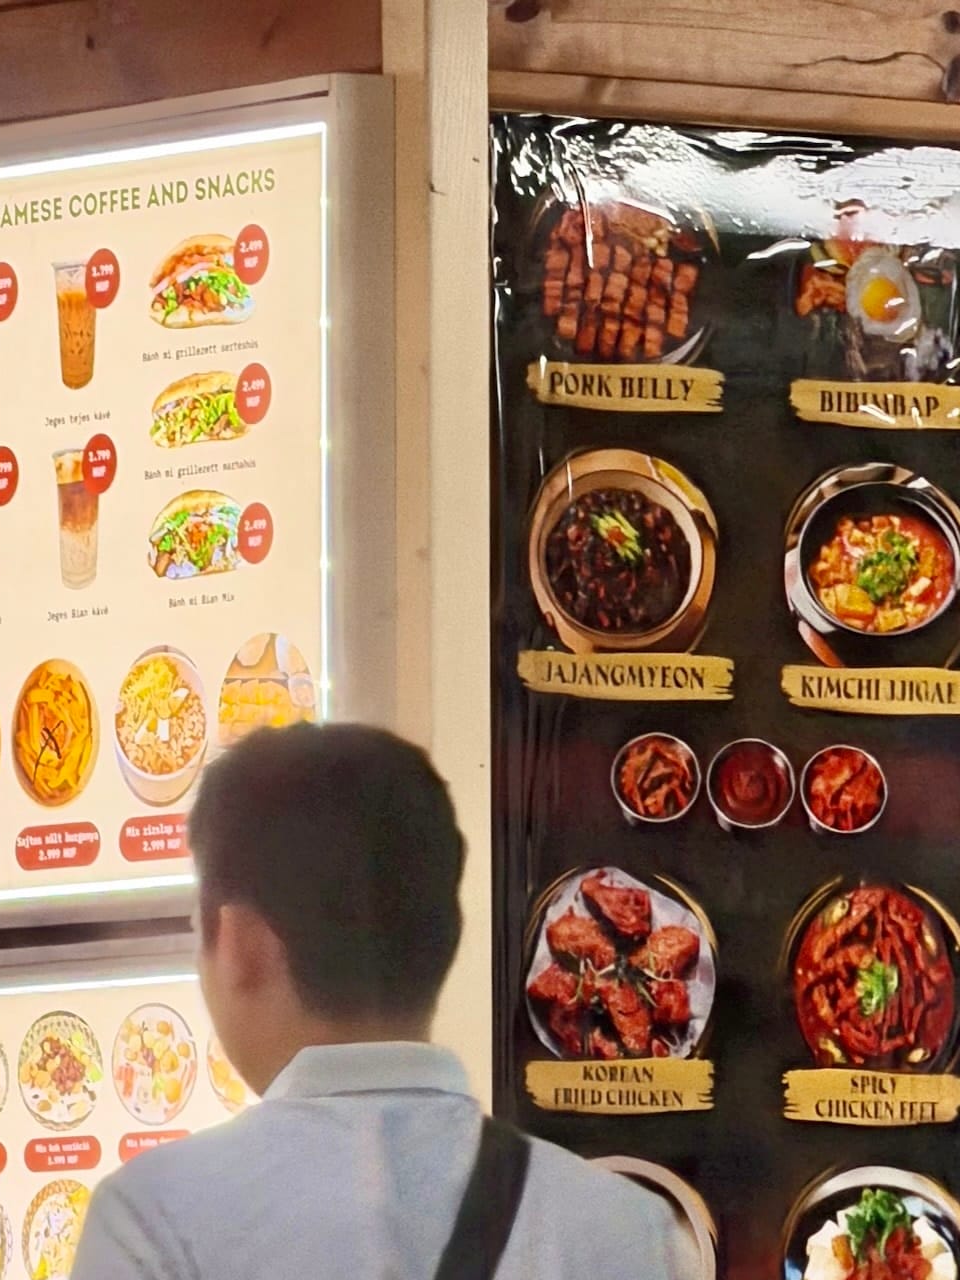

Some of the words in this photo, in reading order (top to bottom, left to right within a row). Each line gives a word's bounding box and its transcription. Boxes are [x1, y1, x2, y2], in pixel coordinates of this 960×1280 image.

[69, 187, 141, 219] COFFEE
[147, 179, 189, 208] AND
[195, 168, 276, 199] SNACKS
[549, 370, 613, 399] PORK
[621, 374, 695, 401] BELLY
[819, 388, 940, 419] BIBIMBAP
[44, 416, 65, 428] Jeges
[47, 611, 68, 624] Jeges
[542, 660, 707, 691] JAJANGMYEON
[801, 673, 880, 701] KIMCHI
[582, 1065, 654, 1084] KOREAN
[850, 1074, 897, 1096] SPICY
[553, 1087, 602, 1107] FRIED
[605, 1088, 684, 1108] CHICKEN
[815, 1098, 895, 1121] CHICKEN
[899, 1101, 940, 1122] FEET
